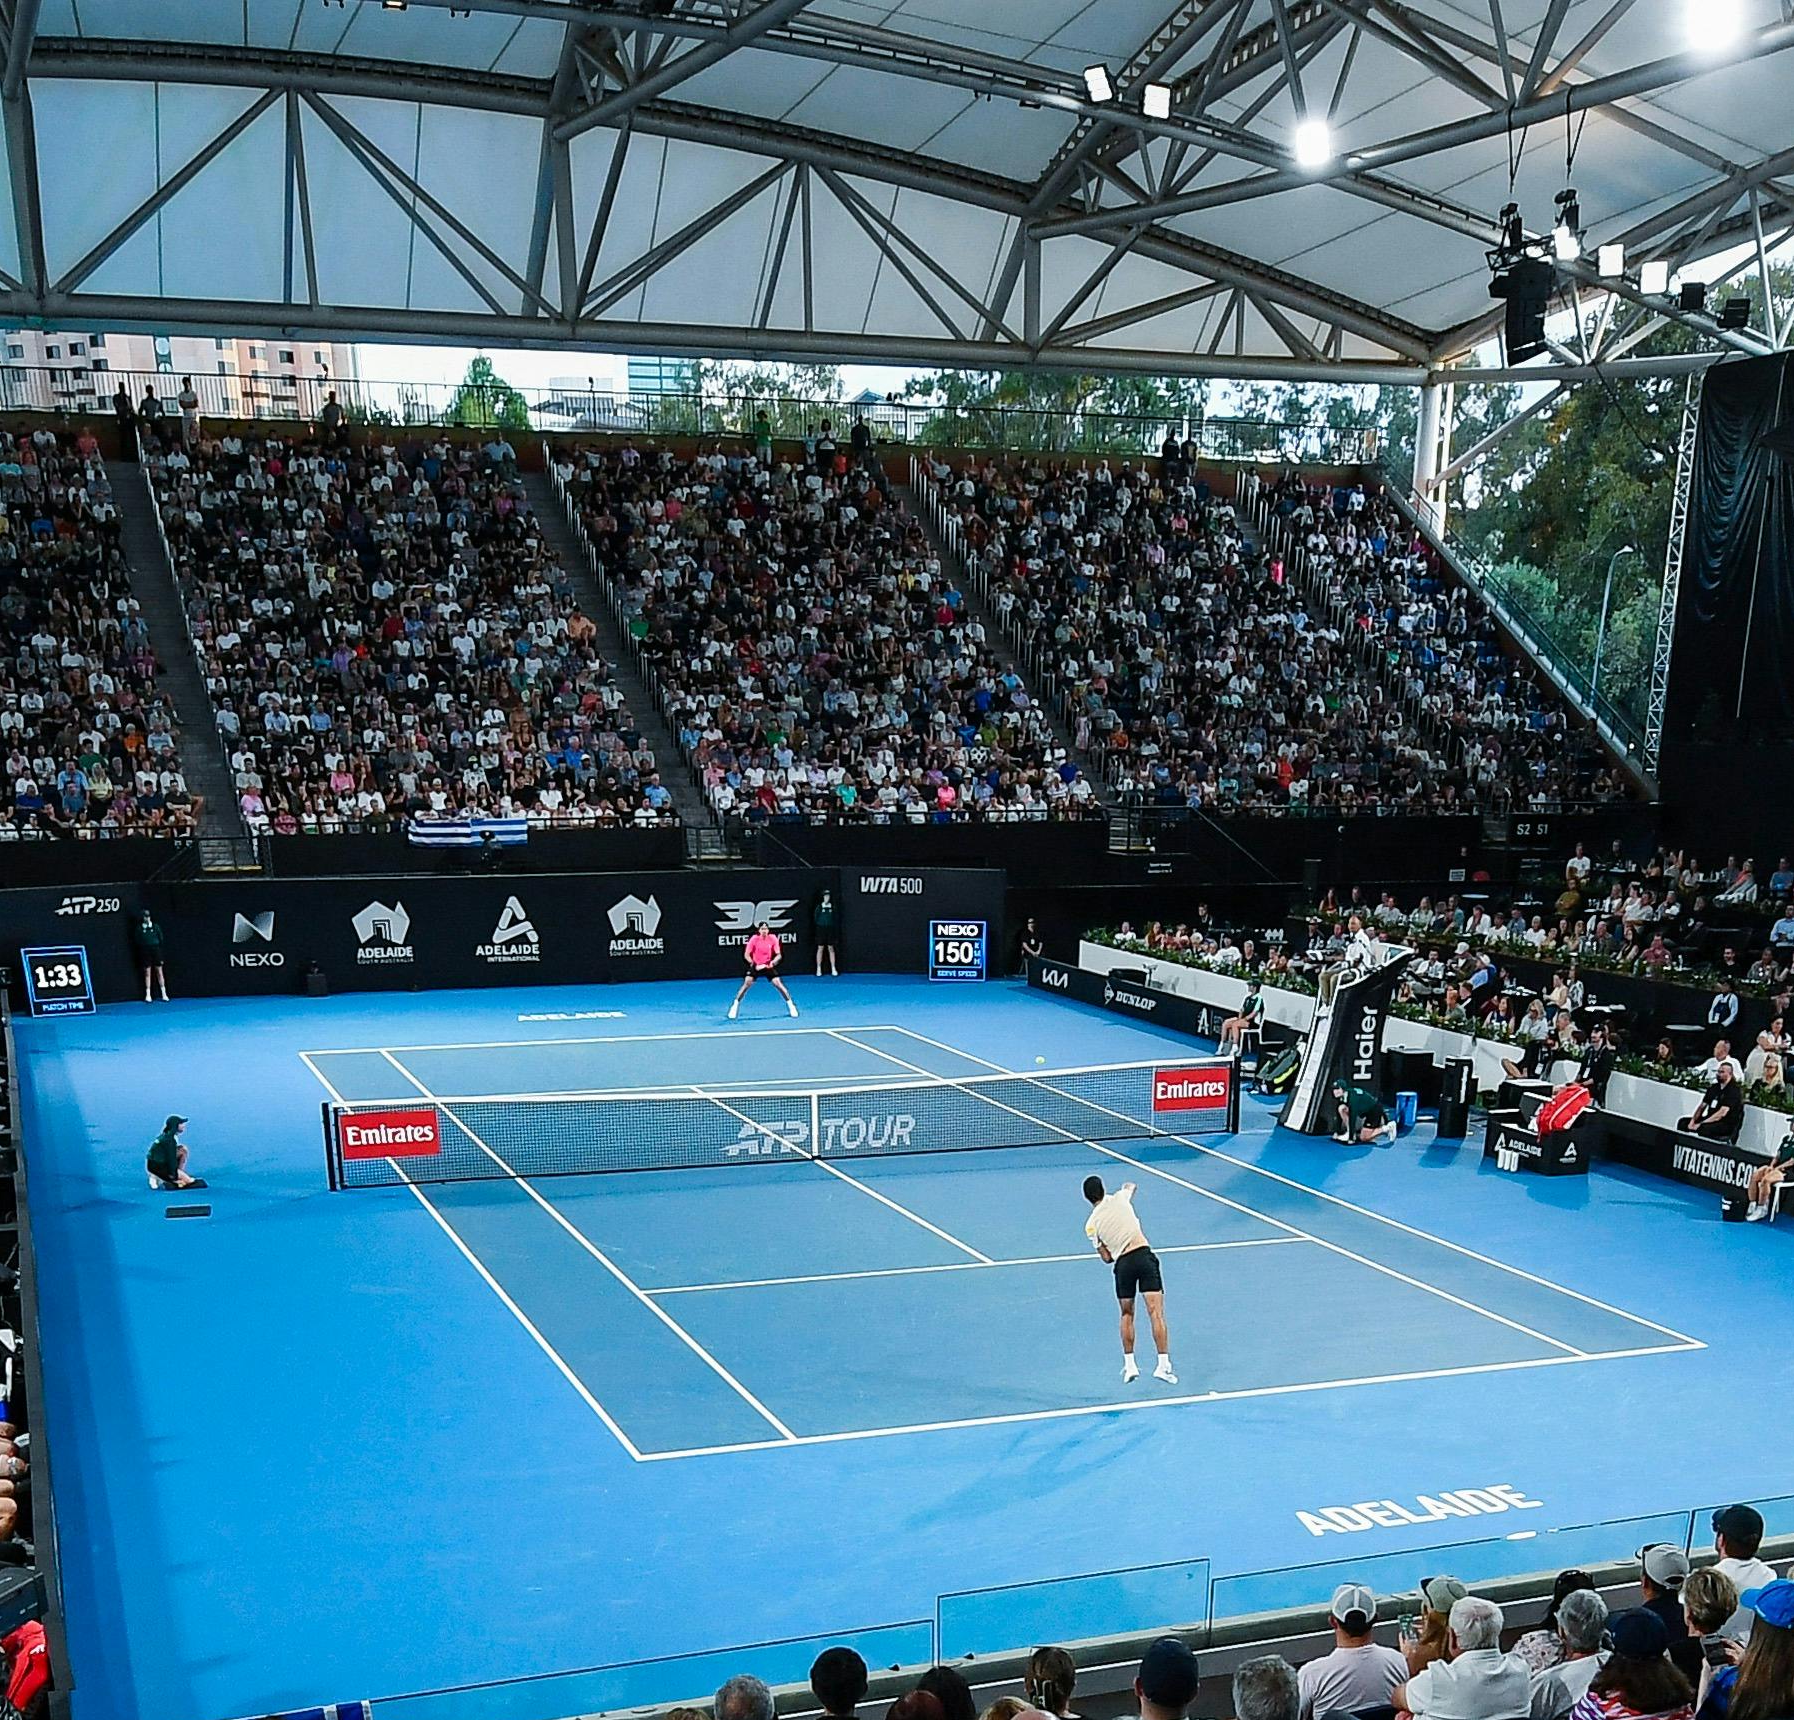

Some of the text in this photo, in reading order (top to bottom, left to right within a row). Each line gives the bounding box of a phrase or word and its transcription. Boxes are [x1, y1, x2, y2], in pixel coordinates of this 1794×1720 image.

[1516, 824, 1531, 835] S2
[860, 876, 922, 894] WTA 500
[55, 896, 120, 915] ATP 250
[937, 924, 979, 936] NEXO
[609, 937, 664, 951] ADELAIDE
[718, 934, 750, 946] ELITE
[230, 952, 285, 967] NEXO
[357, 946, 414, 959] ADELAIDE
[475, 944, 540, 956] ADELAIDE
[935, 941, 974, 963] 150
[34, 963, 82, 988] 1:33
[1115, 990, 1156, 1011] DUNLOP
[1353, 1005, 1378, 1080] Haier
[1156, 1080, 1226, 1100] Emirates
[345, 1122, 435, 1146] Emirates
[717, 1114, 917, 1157] ATP TOUR
[1508, 1139, 1542, 1157] ADELAIDE
[1673, 1144, 1758, 1189] WTATENNIS.CO
[1295, 1484, 1544, 1537] ADELAIDE
